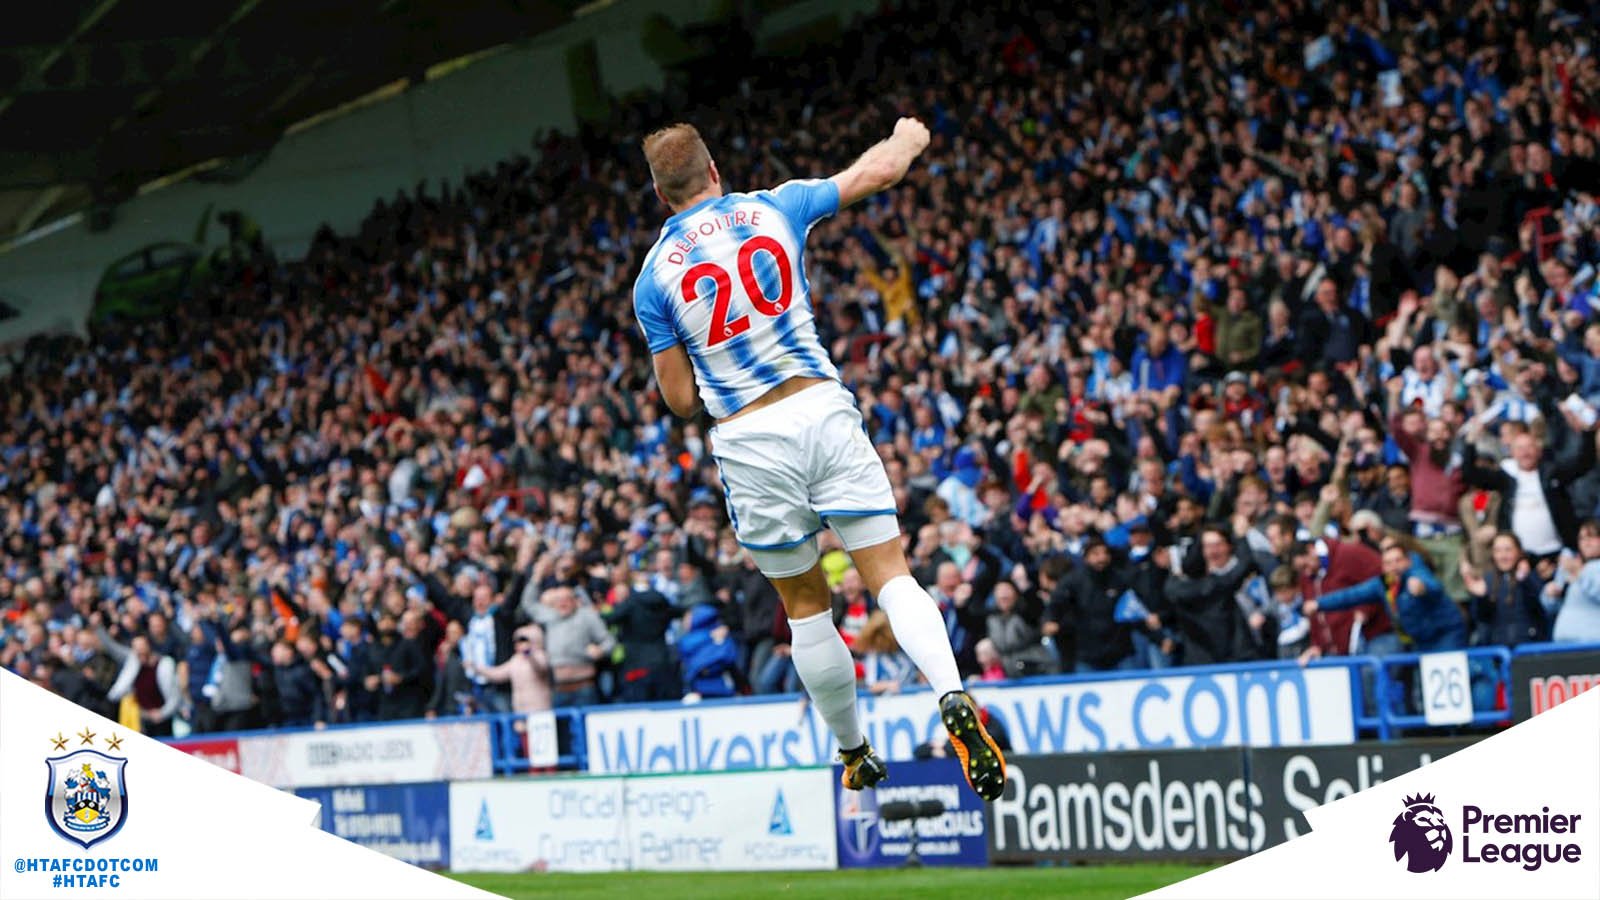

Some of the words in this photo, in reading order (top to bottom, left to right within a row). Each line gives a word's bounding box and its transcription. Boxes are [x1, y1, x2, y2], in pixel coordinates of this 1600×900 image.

[668, 211, 762, 265] DEPOITRE
[681, 235, 793, 347] 20
[1429, 666, 1466, 709] 26
[993, 759, 1265, 851] Ramsdens
